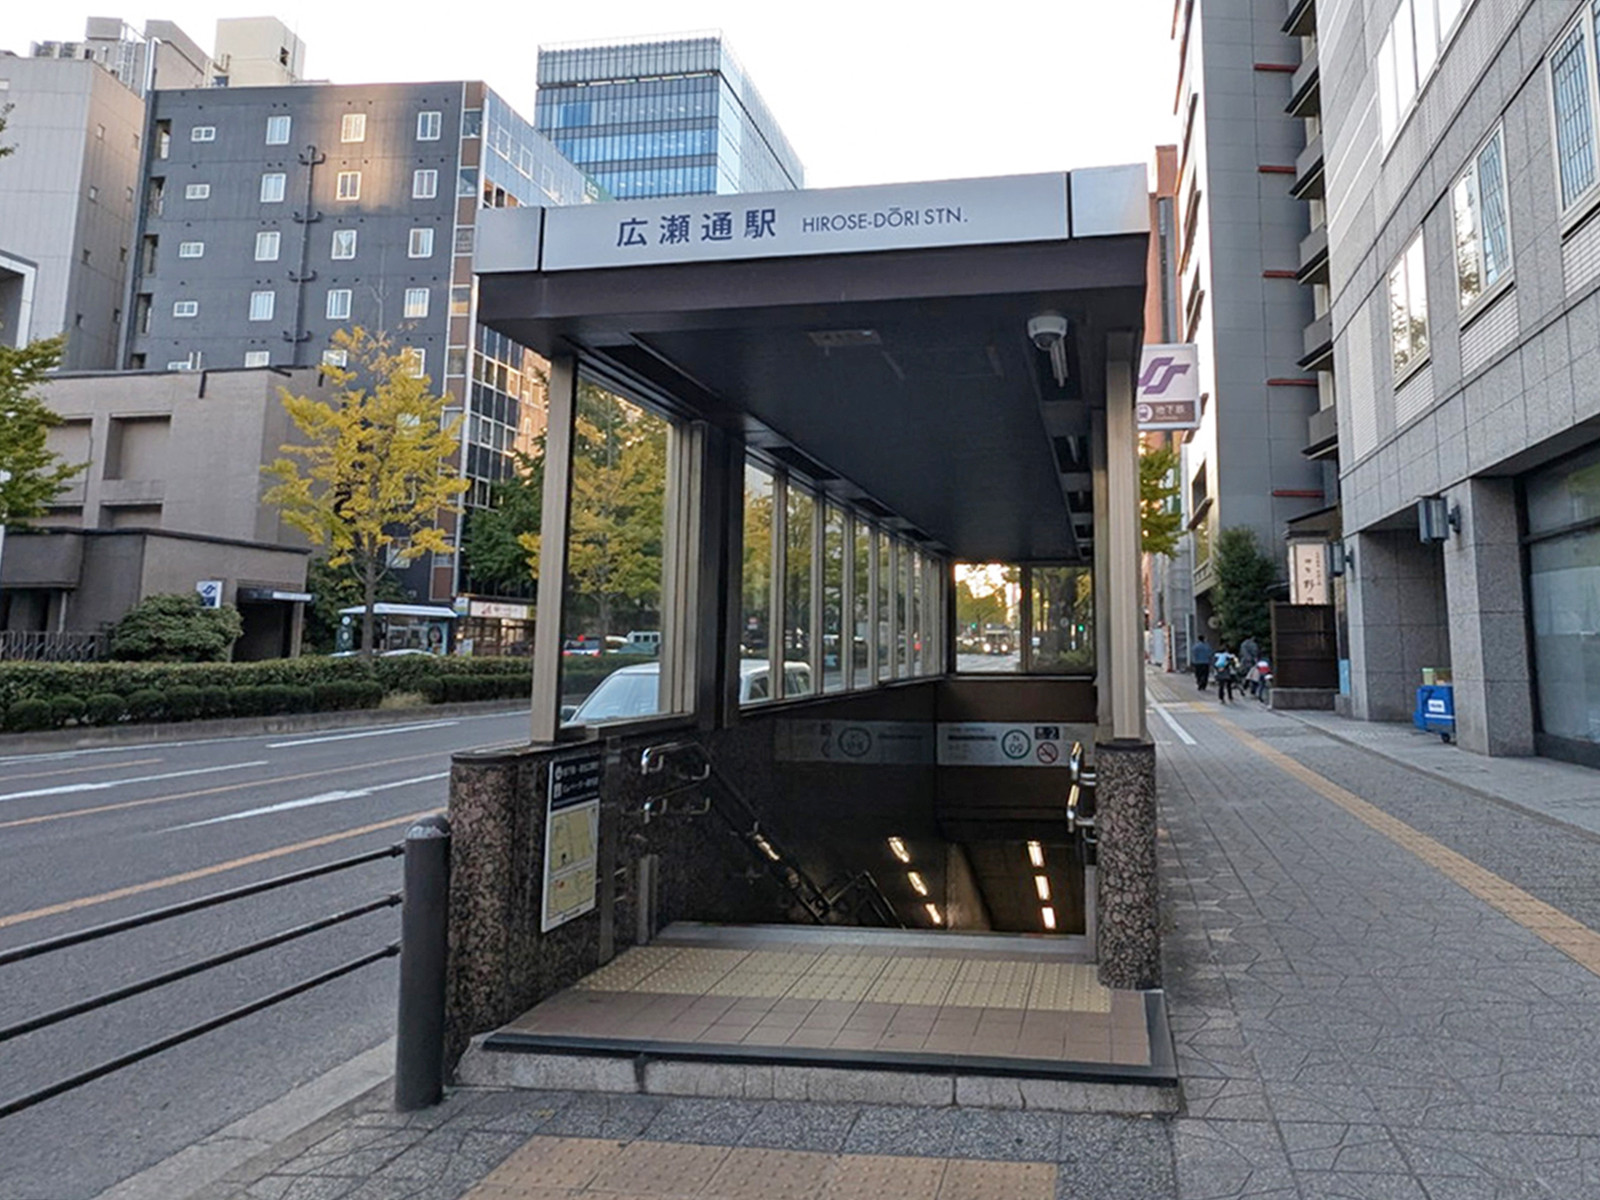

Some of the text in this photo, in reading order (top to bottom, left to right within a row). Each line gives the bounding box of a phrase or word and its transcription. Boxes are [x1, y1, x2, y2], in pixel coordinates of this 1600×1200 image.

[616, 208, 777, 248] 広瀬通駅
[924, 206, 968, 225] STN.
